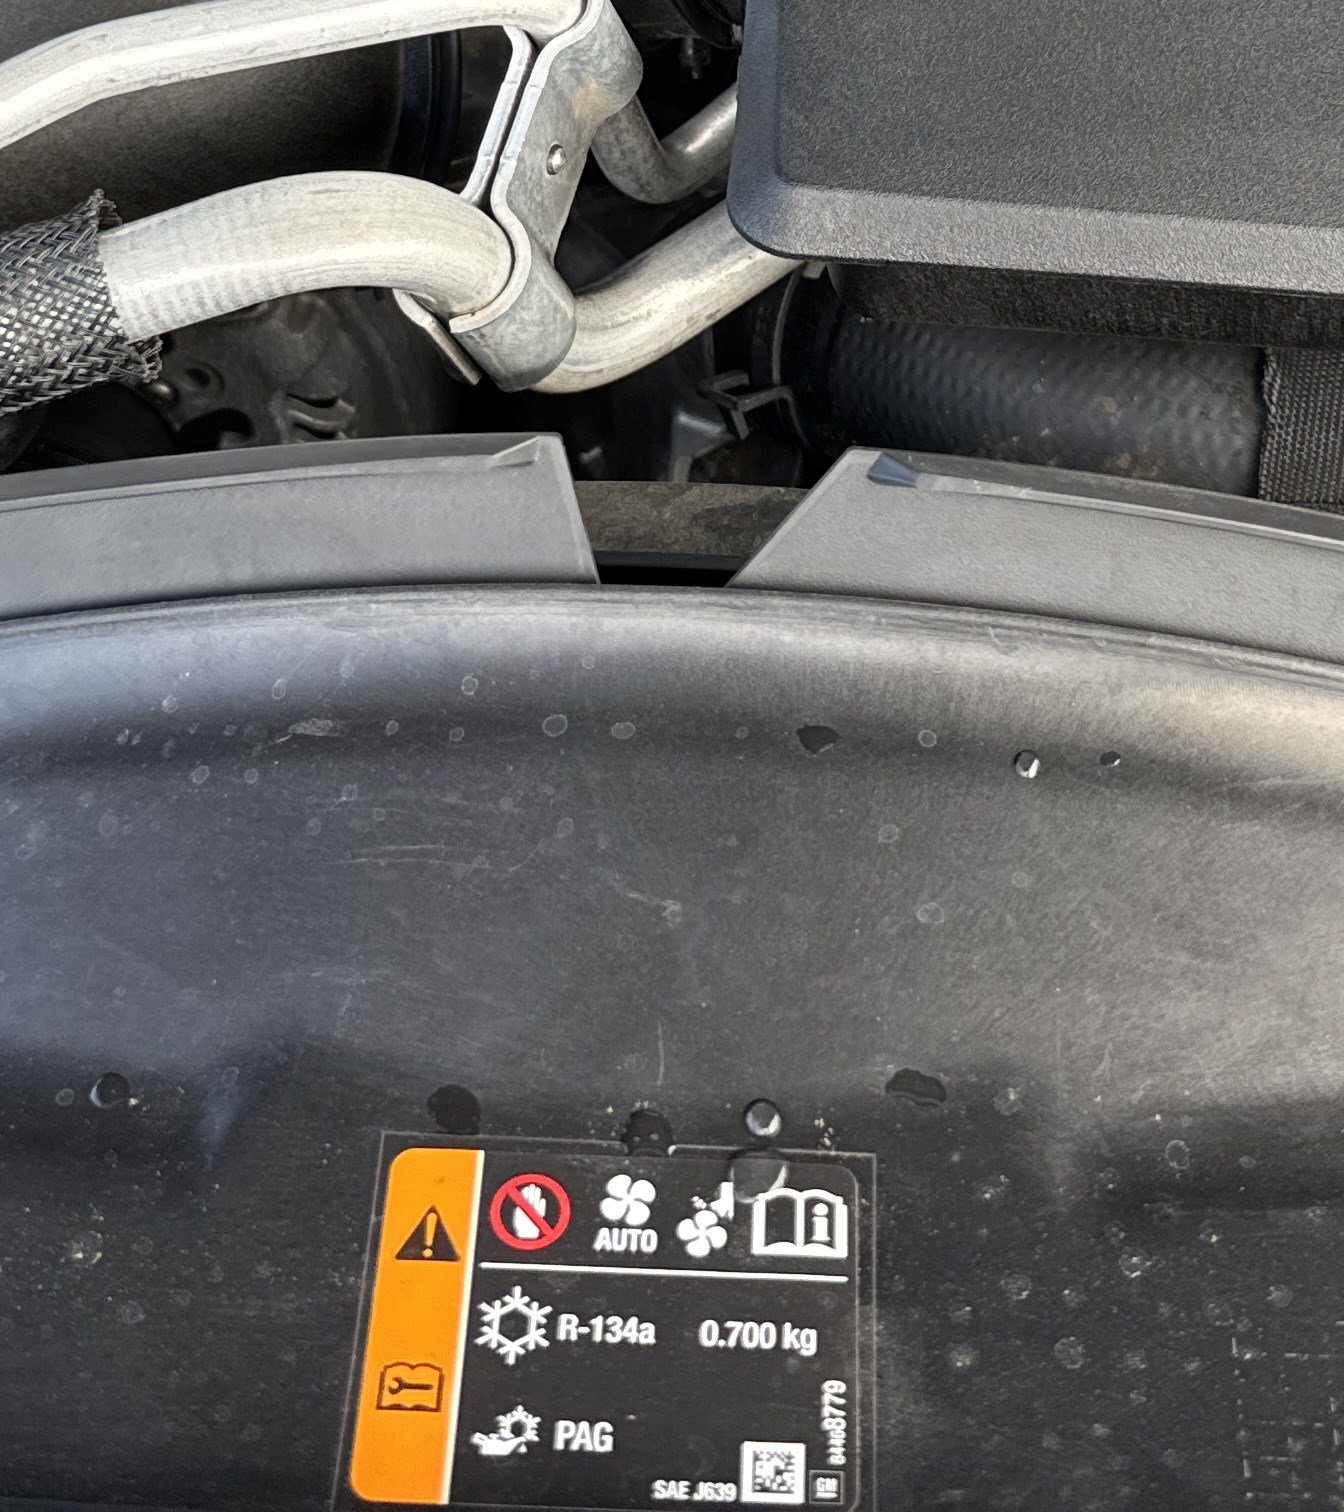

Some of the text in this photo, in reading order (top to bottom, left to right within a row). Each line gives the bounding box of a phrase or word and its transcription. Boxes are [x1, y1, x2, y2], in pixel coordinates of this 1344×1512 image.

[593, 1227, 658, 1253] AUTO
[557, 1313, 818, 1357] R-134a 0.700 kg
[553, 1419, 614, 1453] PAG
[651, 1478, 738, 1502] SAE J639
